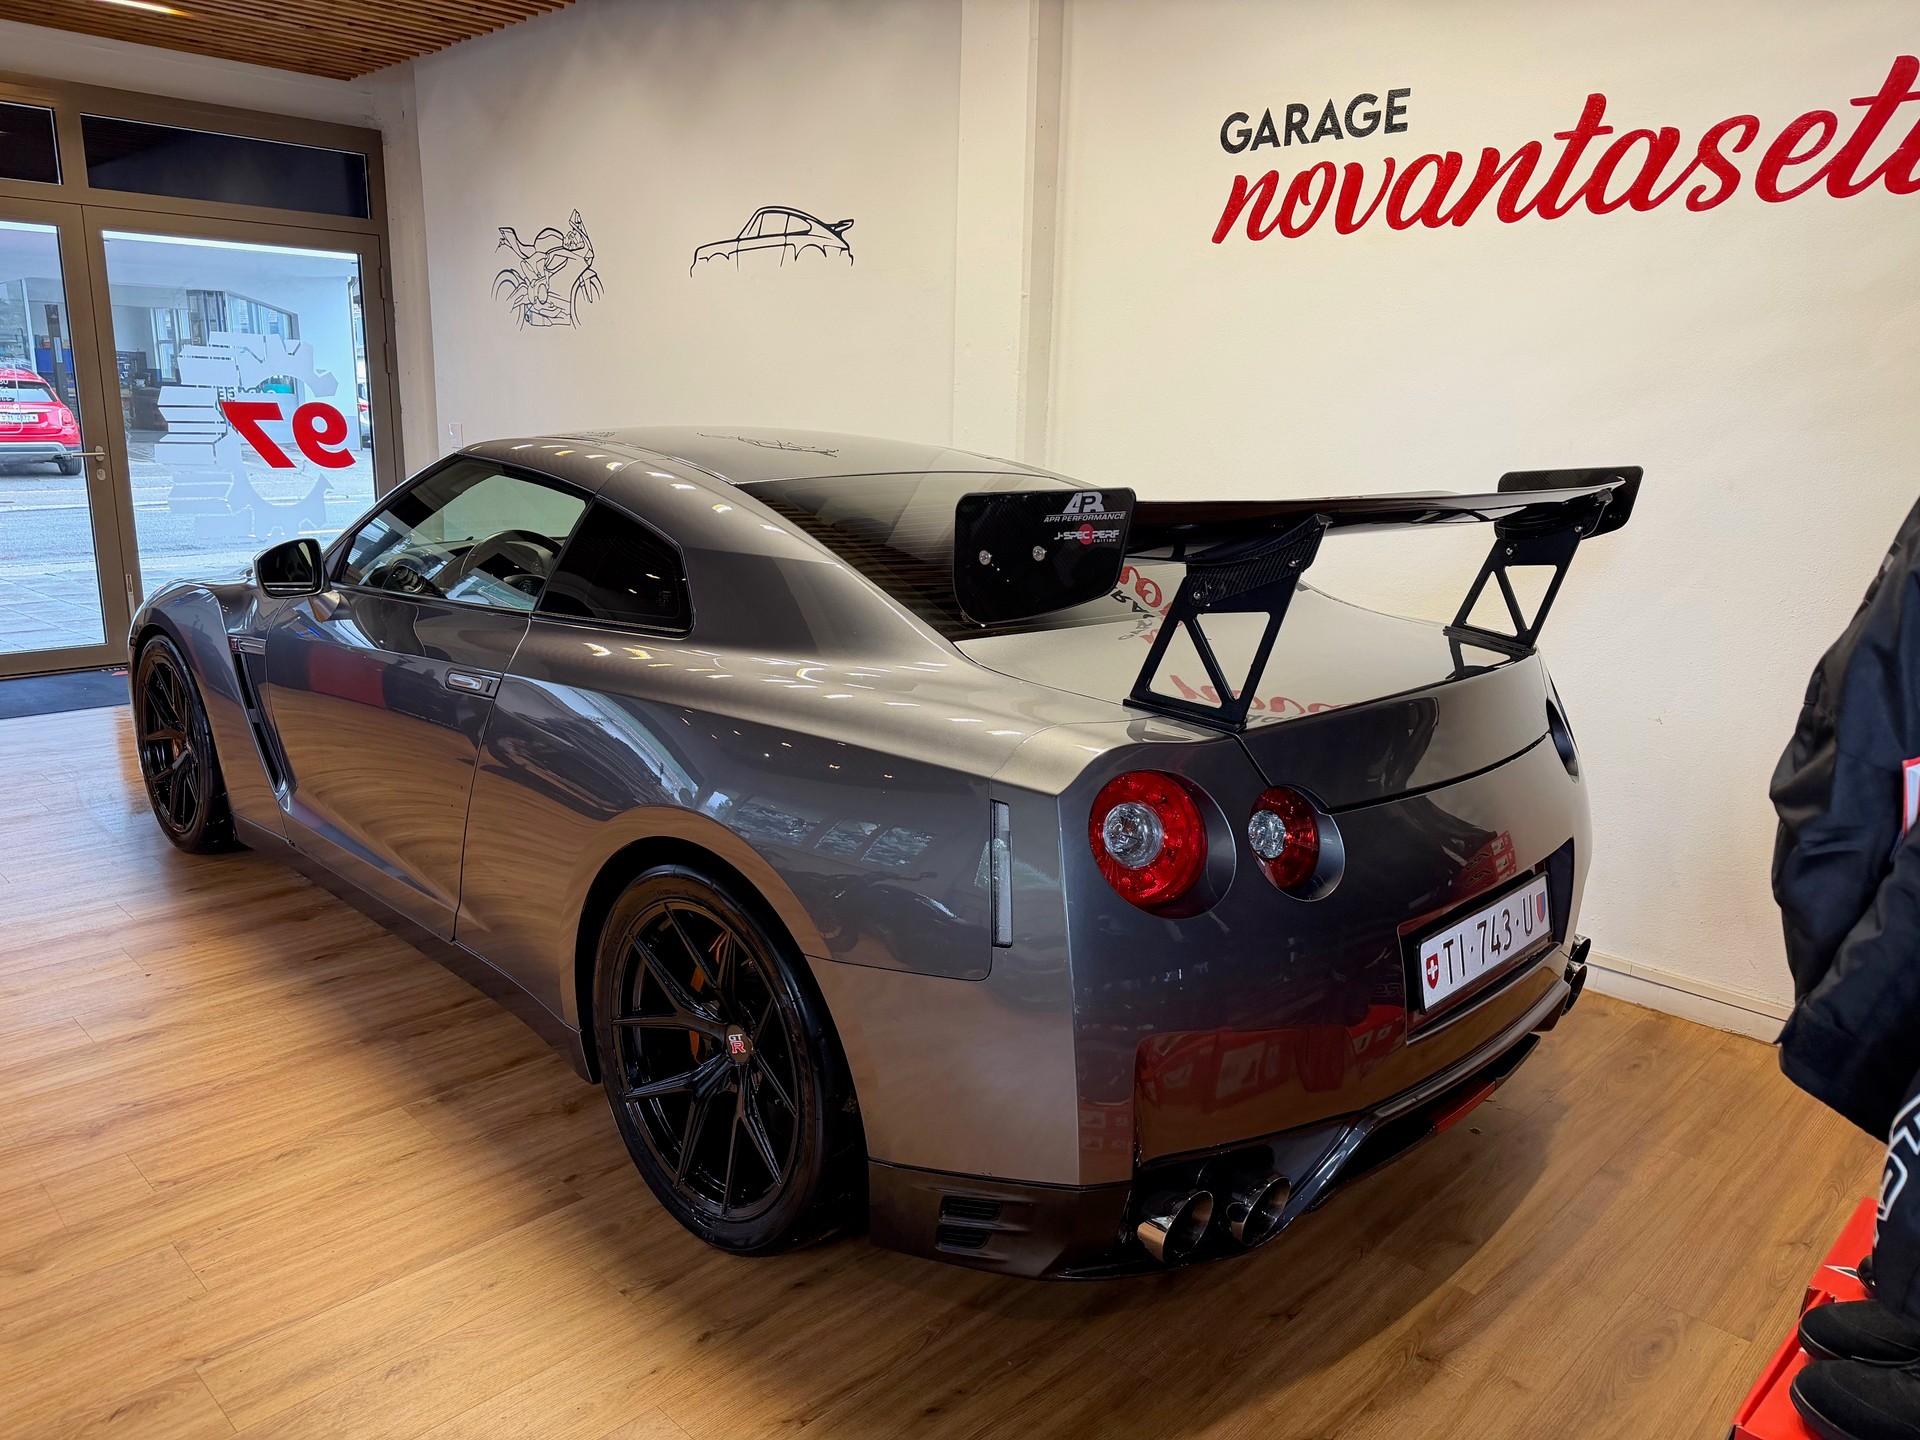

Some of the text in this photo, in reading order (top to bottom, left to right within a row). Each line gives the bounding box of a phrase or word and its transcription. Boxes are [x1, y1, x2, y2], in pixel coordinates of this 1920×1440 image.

[1219, 87, 1412, 155] GARAGE
[1062, 513, 1126, 521] PERFORMANCE
[1092, 530, 1119, 538] PERF
